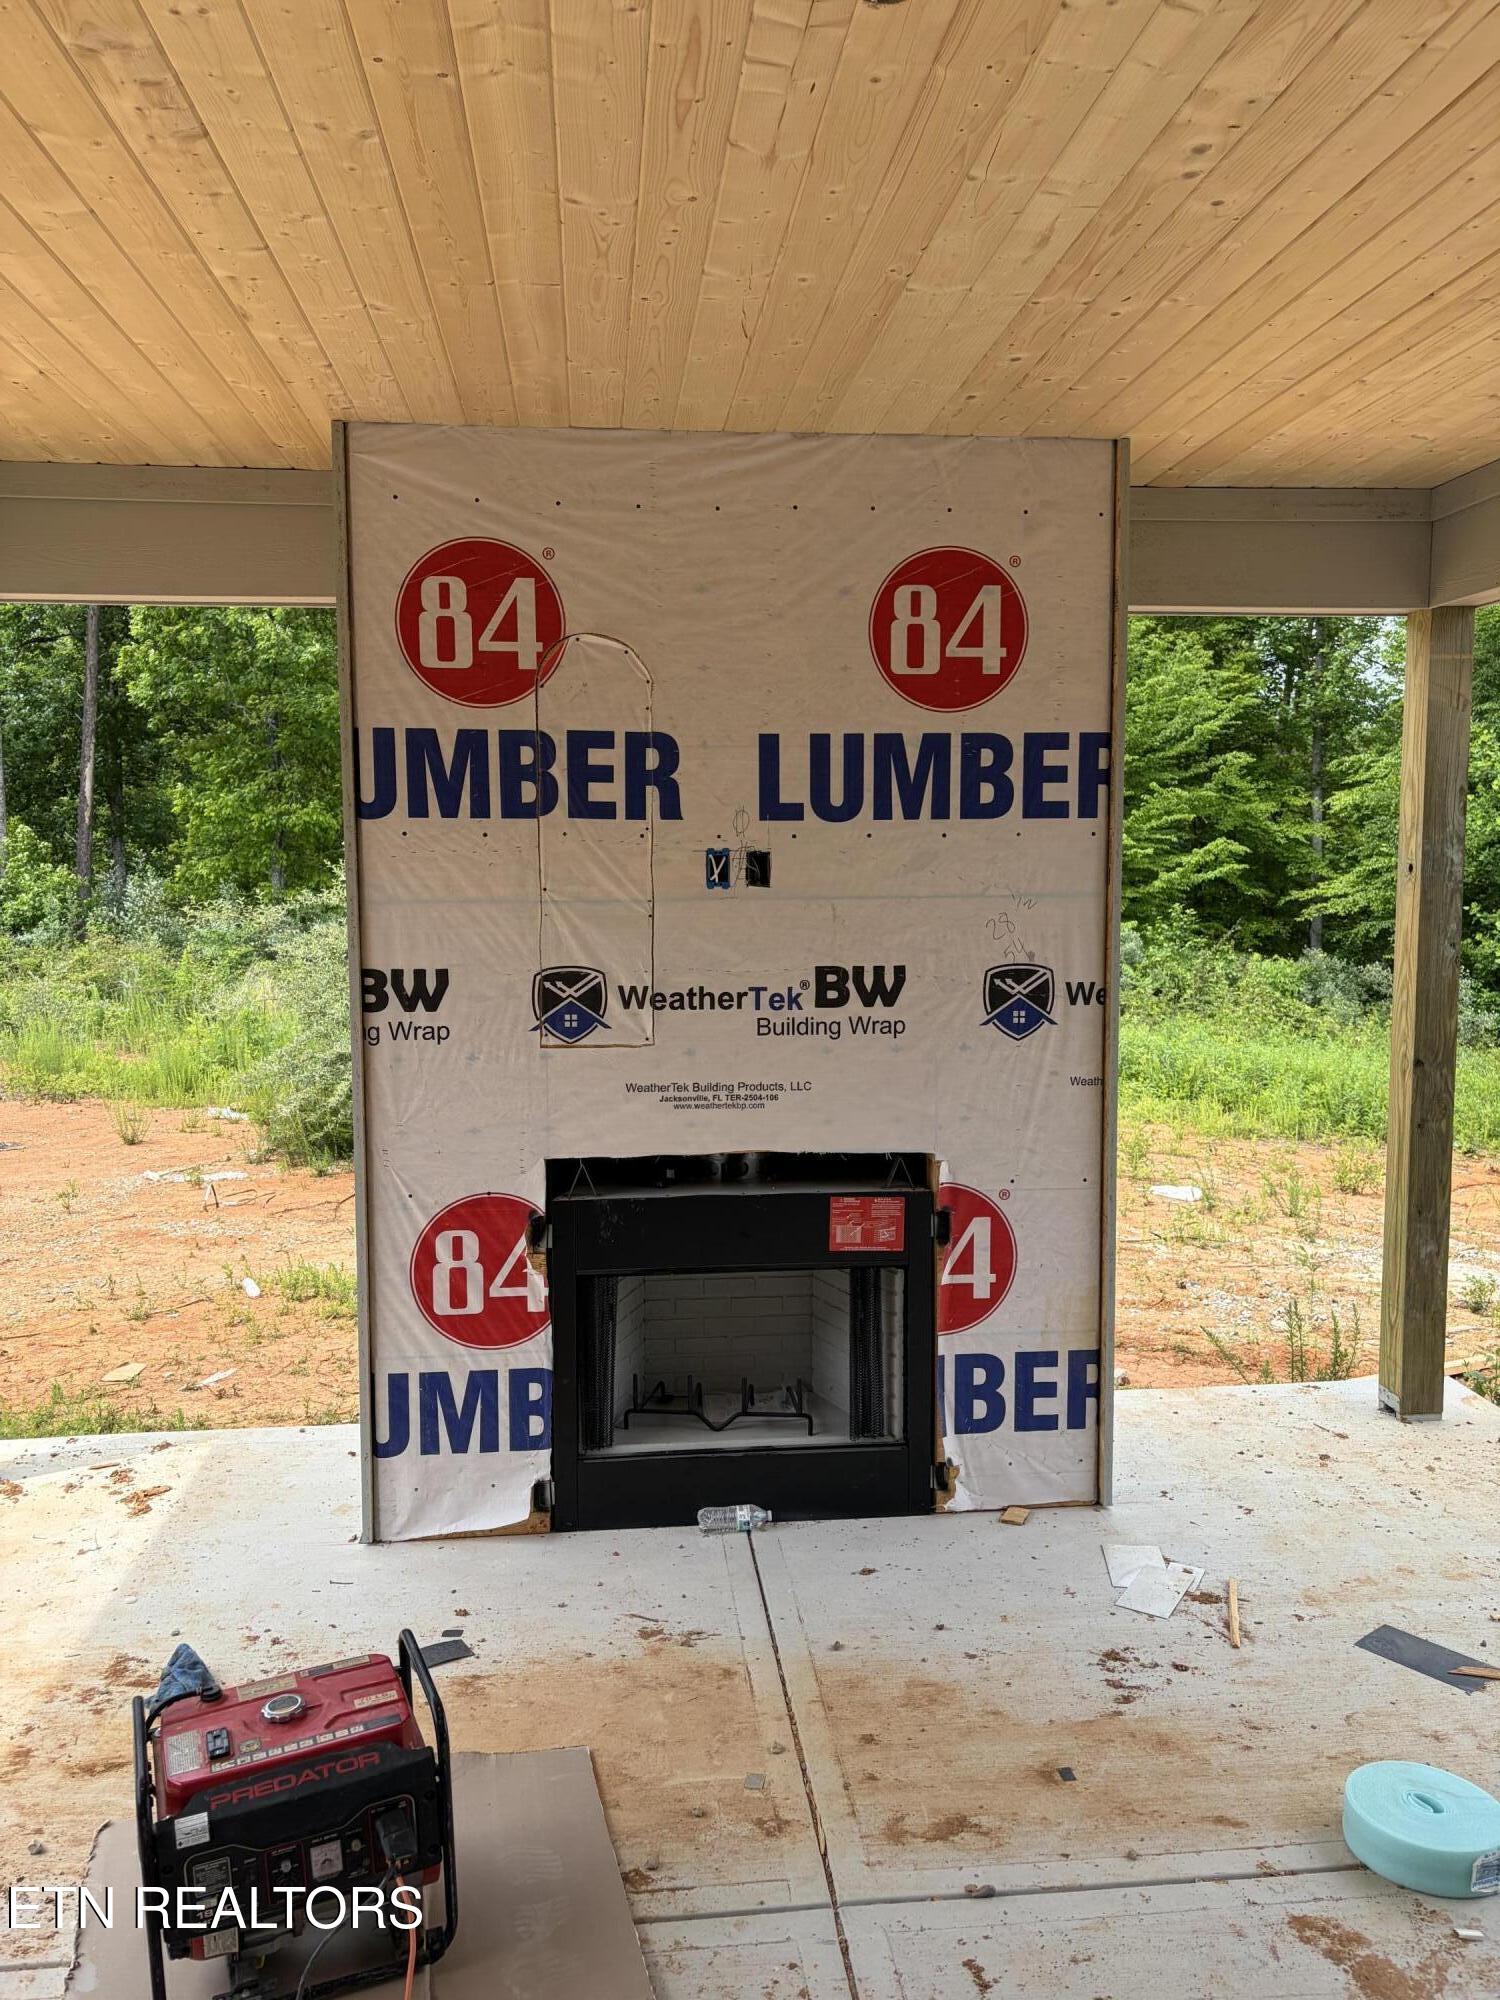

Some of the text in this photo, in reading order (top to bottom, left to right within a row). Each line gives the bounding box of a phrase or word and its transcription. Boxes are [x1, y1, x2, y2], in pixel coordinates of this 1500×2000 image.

[418, 576, 544, 670] 84
[890, 584, 1007, 675] 84
[353, 727, 683, 820] UMBER
[361, 968, 449, 1012] BW
[814, 965, 906, 1008] BW
[388, 1021, 450, 1045] Wrap
[757, 1016, 906, 1040] Building Wrap
[625, 1081, 812, 1094] WeatherTek Building Products, LLC
[432, 1229, 550, 1316] 84
[210, 1751, 381, 1810] PREDATOR
